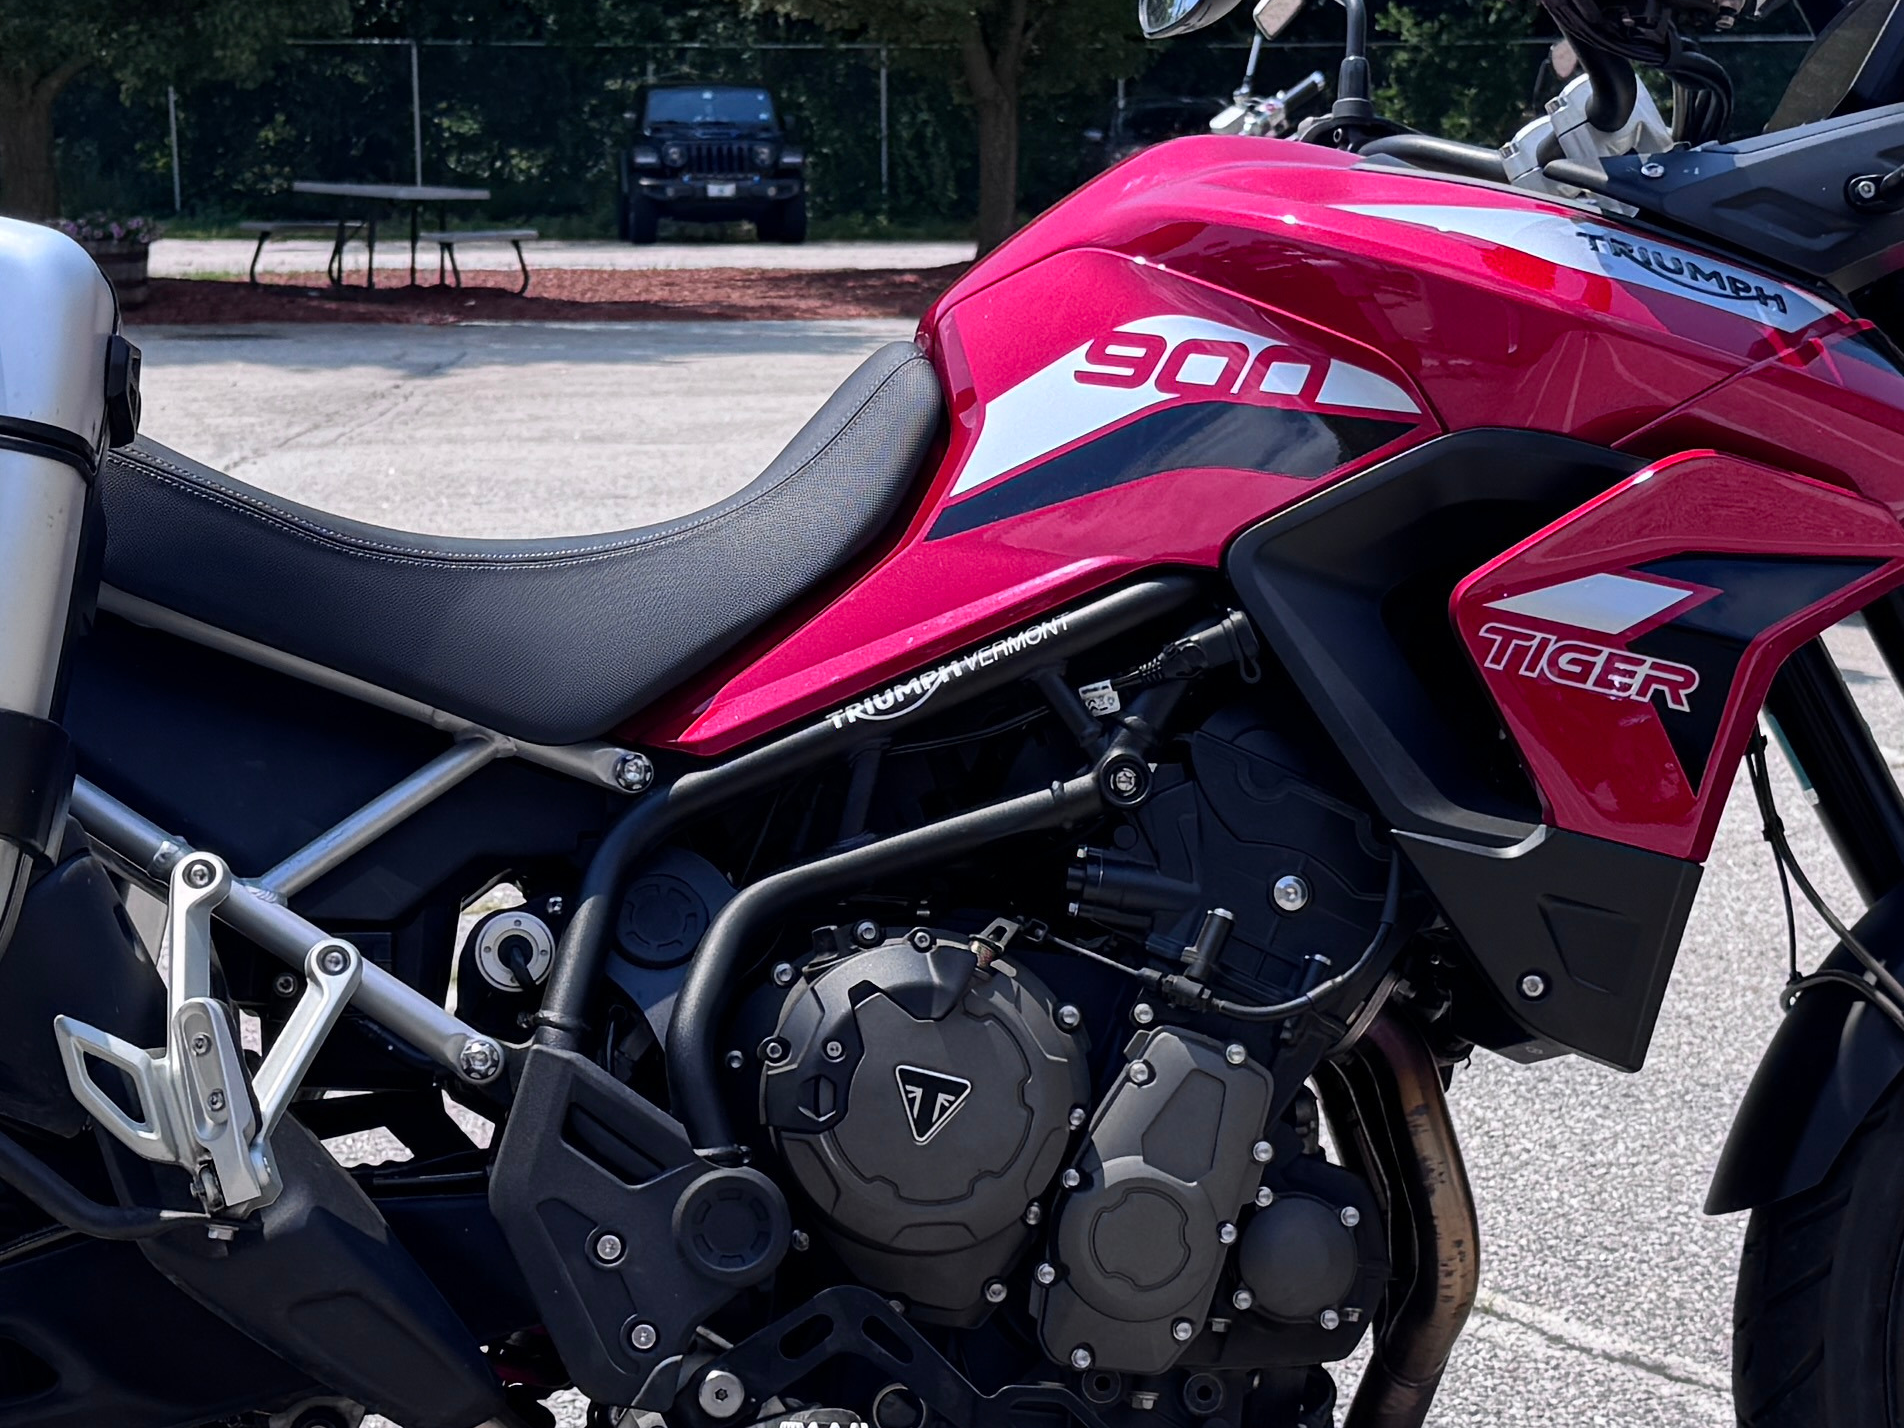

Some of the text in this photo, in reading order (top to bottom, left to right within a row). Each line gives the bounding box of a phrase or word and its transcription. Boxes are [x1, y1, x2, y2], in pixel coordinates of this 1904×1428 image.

[1575, 231, 1788, 314] TRIUMPH
[1074, 330, 1332, 404] 900
[825, 611, 1071, 730] TRIUMPH VERMONT
[1478, 622, 1701, 712] TIGER
